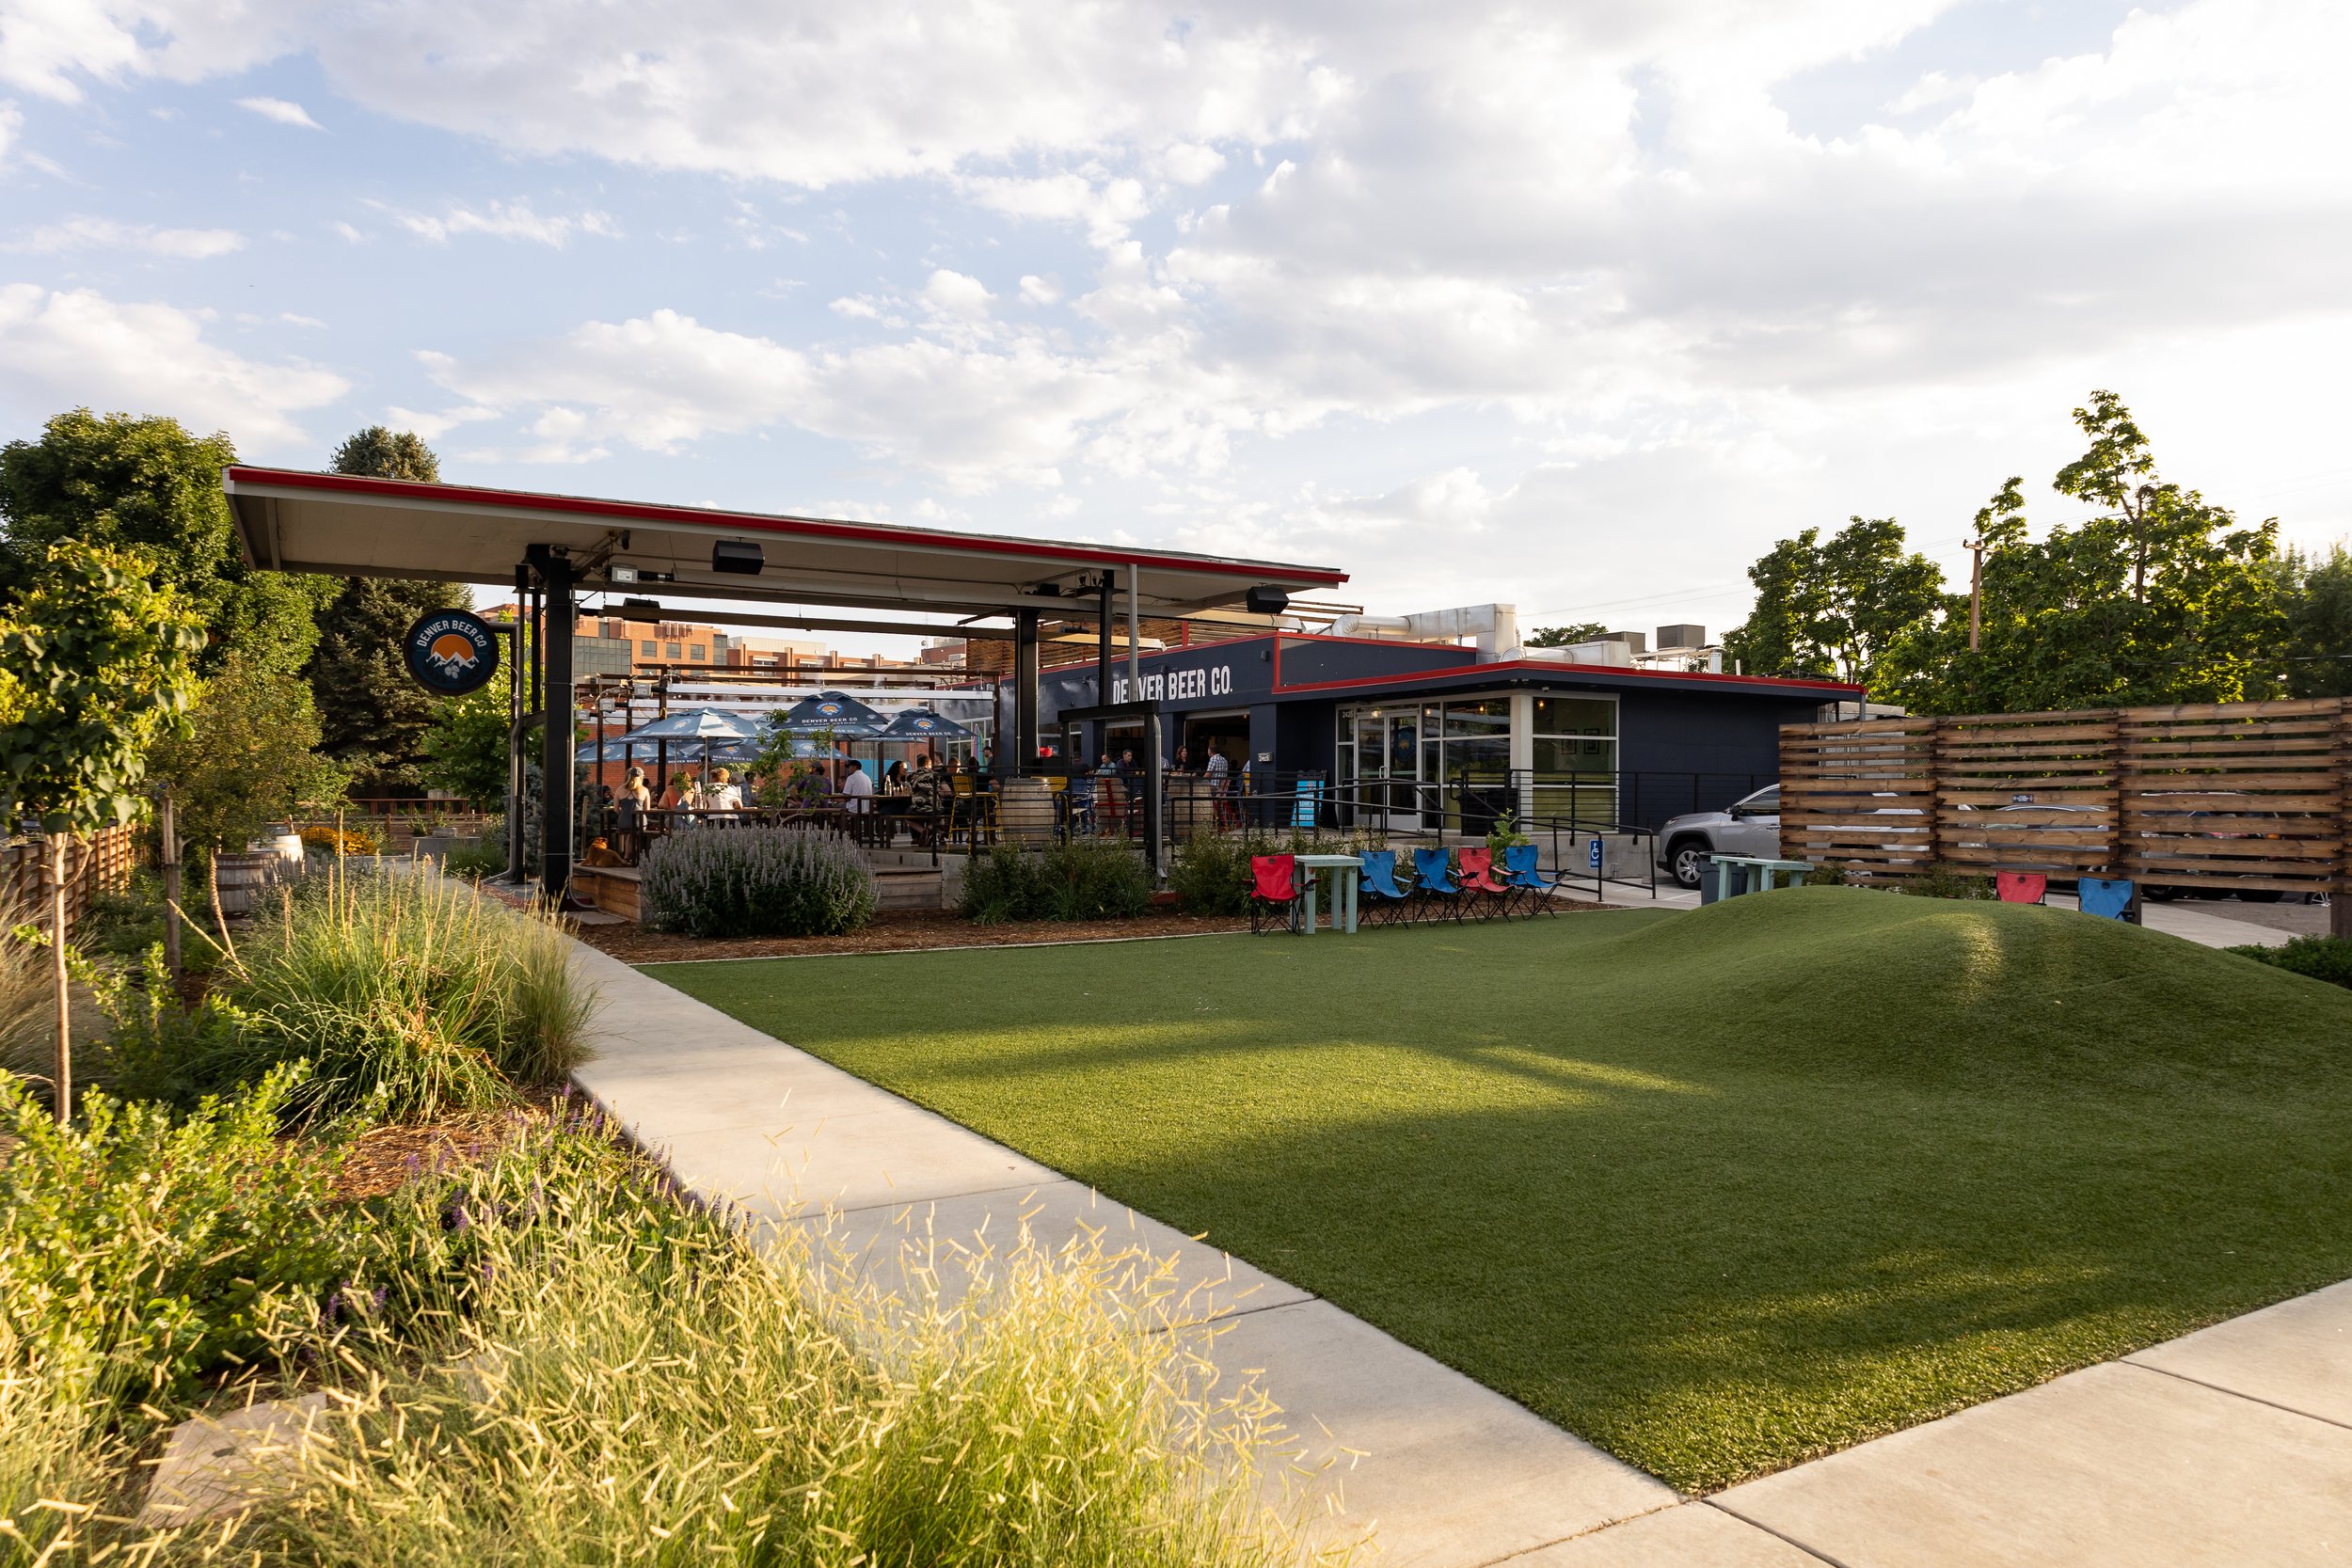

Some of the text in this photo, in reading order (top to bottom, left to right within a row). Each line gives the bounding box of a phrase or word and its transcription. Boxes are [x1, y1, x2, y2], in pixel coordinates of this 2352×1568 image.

[417, 620, 487, 647] DENVER BEER CO
[1113, 666, 1233, 705] DEVER BEER CO.
